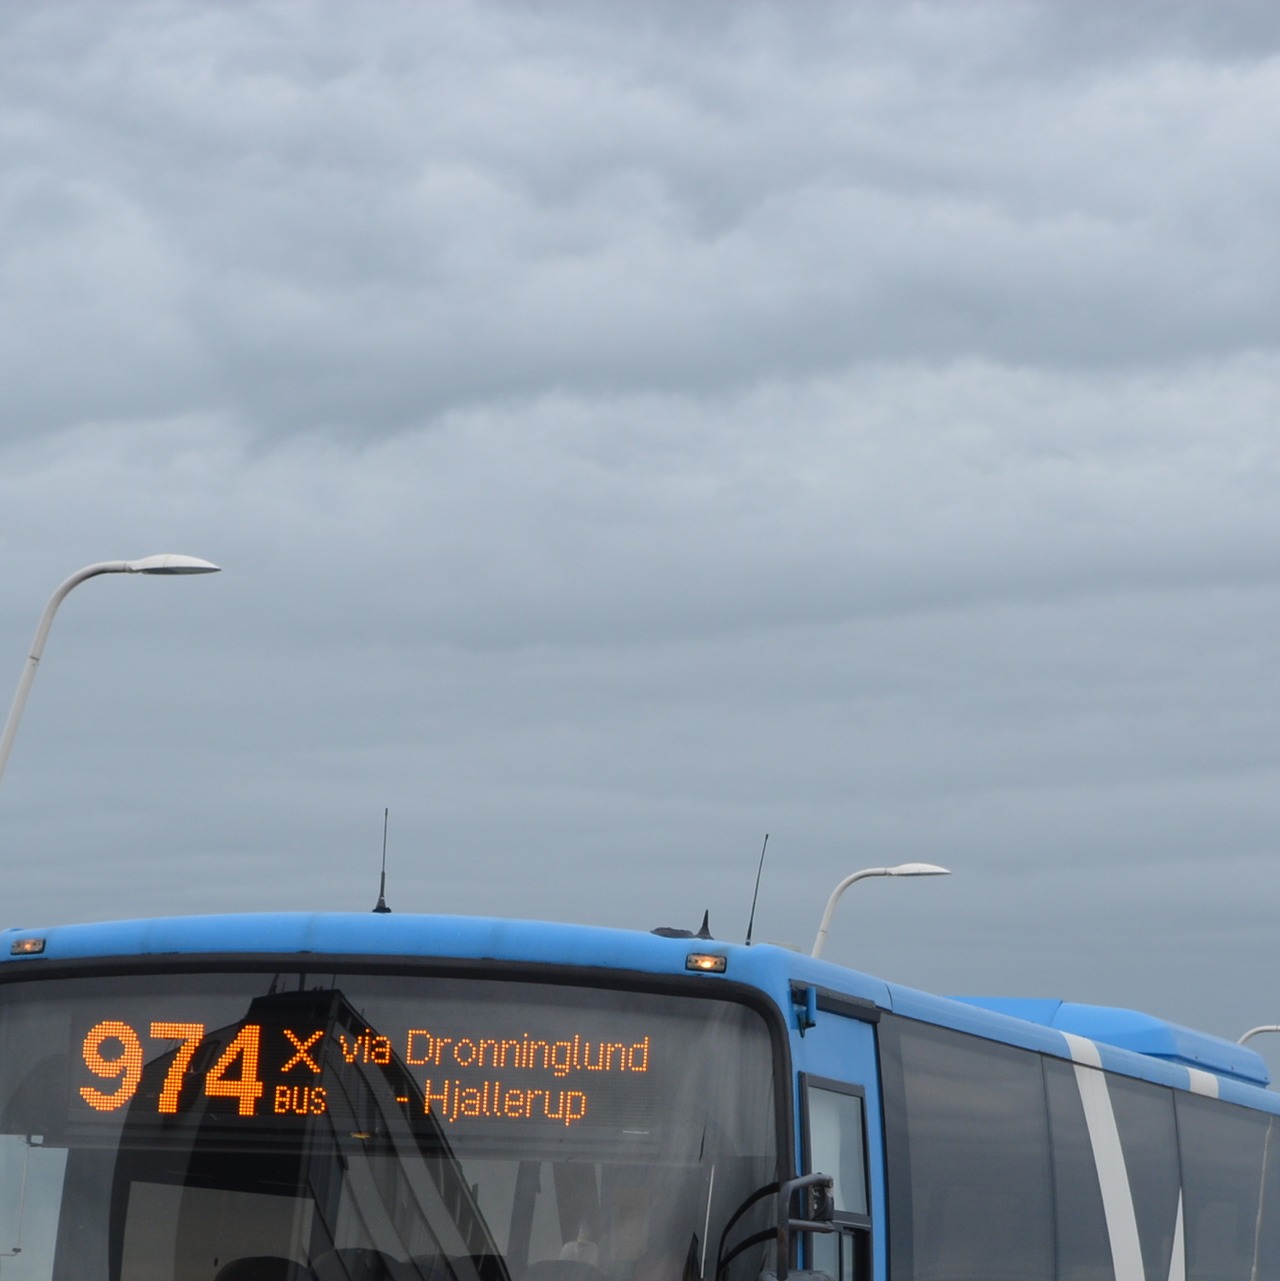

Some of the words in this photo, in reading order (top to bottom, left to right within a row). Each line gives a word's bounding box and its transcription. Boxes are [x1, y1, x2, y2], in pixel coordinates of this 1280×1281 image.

[79, 1020, 263, 1116] 974
[280, 1029, 324, 1074] X
[339, 1028, 391, 1064] via
[406, 1029, 650, 1077] Dronninglund
[274, 1085, 327, 1115] BUS
[423, 1079, 587, 1127] Hjallerup
